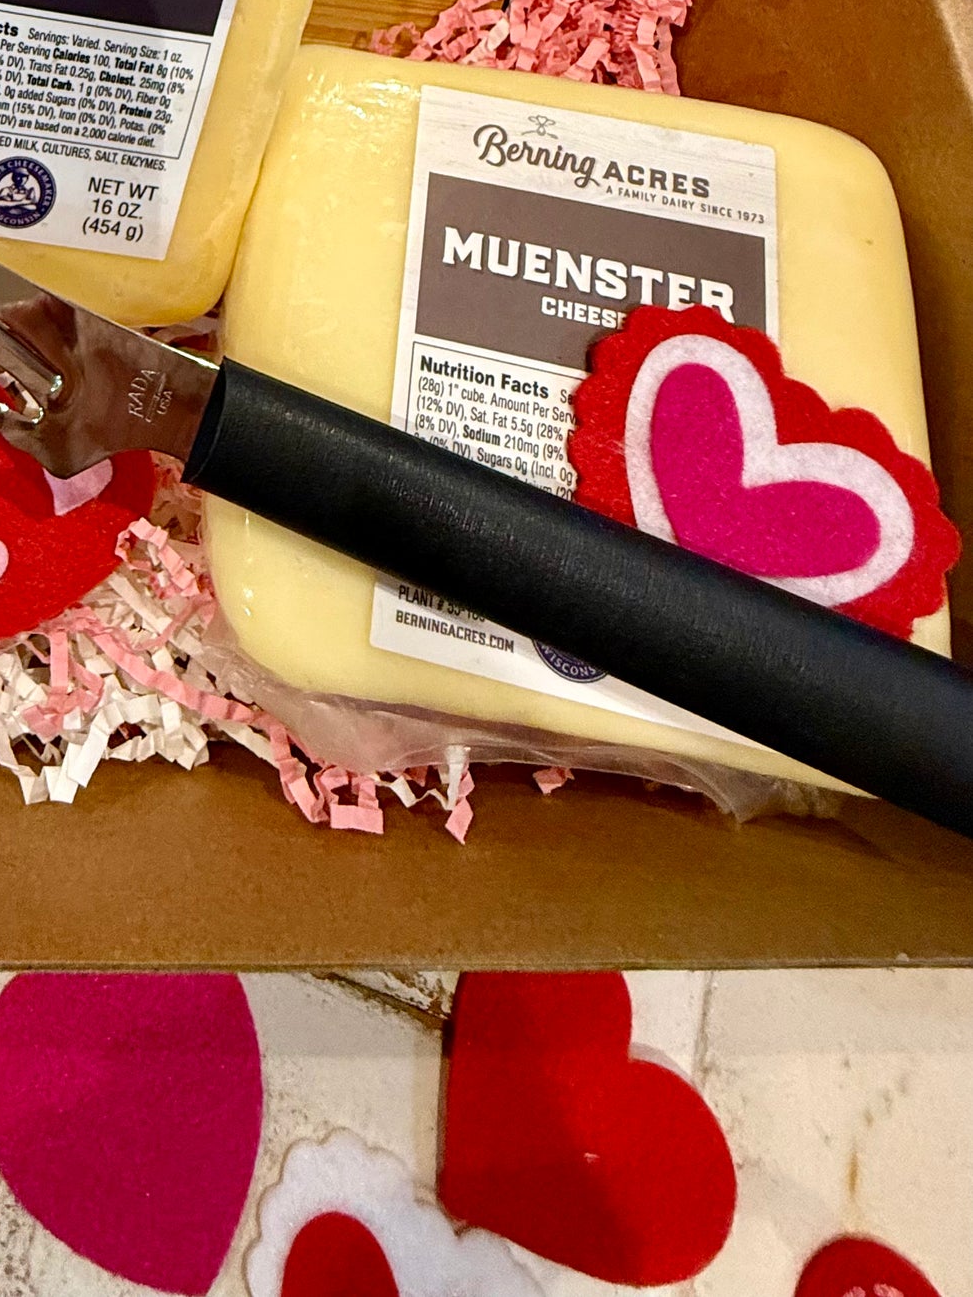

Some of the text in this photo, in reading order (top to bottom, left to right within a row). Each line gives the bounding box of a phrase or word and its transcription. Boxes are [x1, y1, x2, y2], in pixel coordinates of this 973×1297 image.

[27, 27, 70, 47] Servings:
[72, 34, 100, 50] Varied.
[103, 39, 138, 59] Serving
[139, 45, 161, 60] Size:
[163, 49, 169, 61] 1
[170, 52, 182, 63] oz.
[13, 138, 39, 153] MILK,
[41, 141, 92, 161] CULTURES,
[94, 149, 118, 165] SALT,
[120, 153, 165, 171] ENZYMES.
[473, 124, 711, 199] Berning ACRES
[87, 177, 159, 201] NET WT
[605, 185, 765, 225] A FAMILY DAIRY SINCE 1973
[82, 216, 144, 242] (454 g)
[92, 200, 143, 220] 16 OZ.
[442, 226, 735, 324] MUENSTER
[128, 369, 157, 418] RADA
[420, 355, 549, 400] Nutrition Facts
[156, 391, 173, 415] USA
[395, 609, 515, 653] BERNINGACRES.COM
